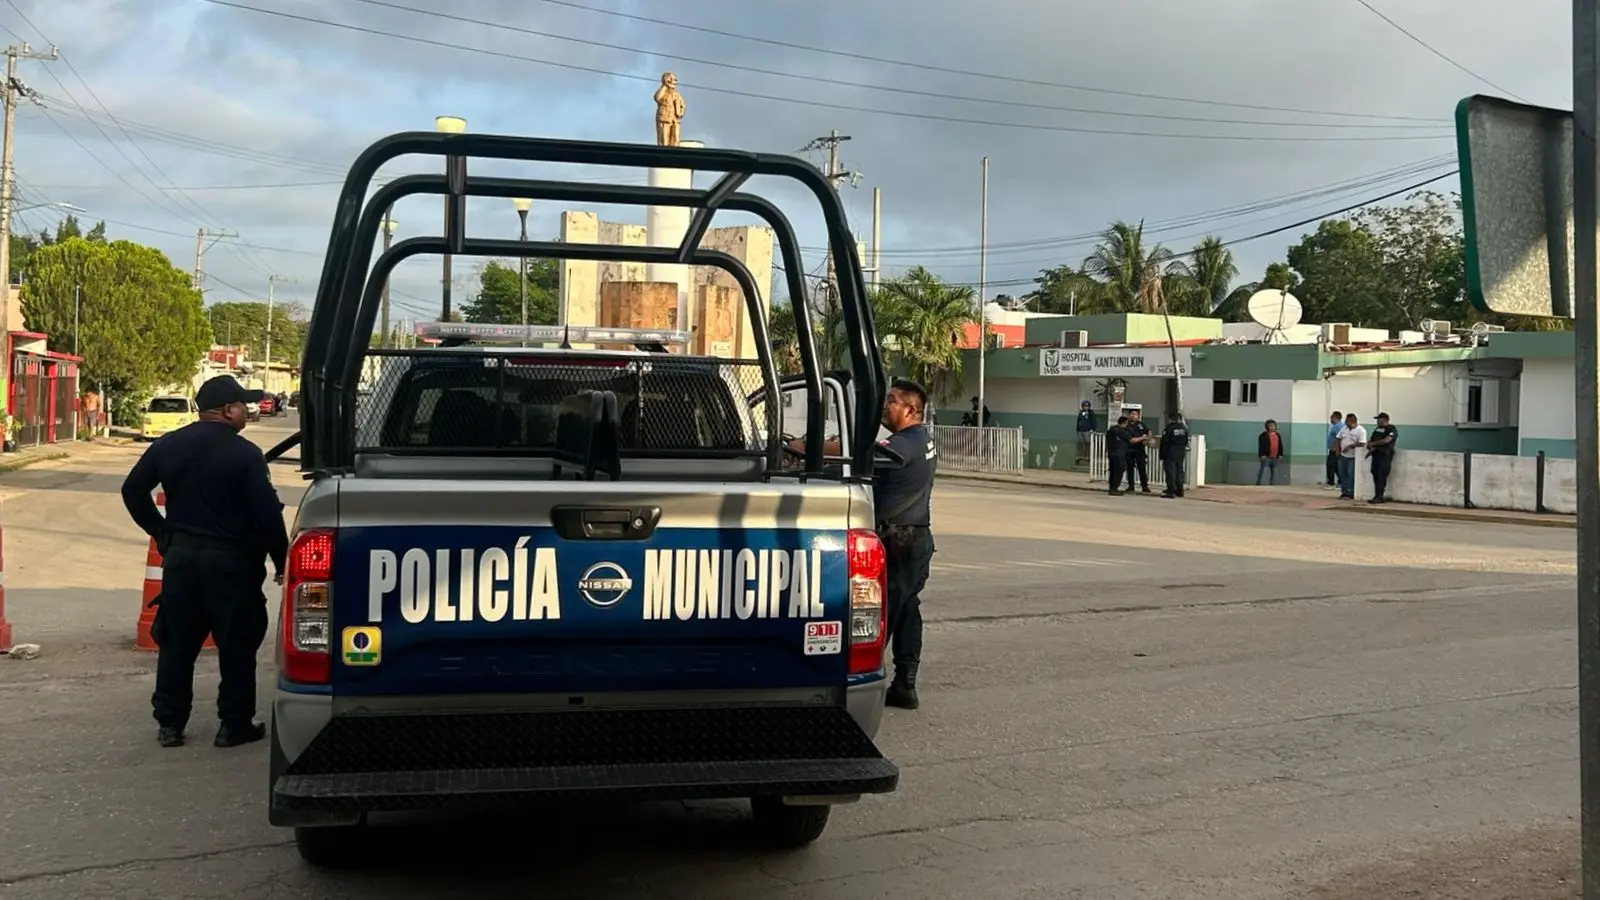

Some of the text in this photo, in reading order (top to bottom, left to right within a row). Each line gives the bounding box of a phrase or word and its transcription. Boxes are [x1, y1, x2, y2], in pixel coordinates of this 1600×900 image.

[1061, 353, 1144, 368] HOSPITAL KANTUNILKIN
[368, 537, 824, 622] POLICÍA MUNICIPAL
[578, 580, 631, 589] NISSAN
[809, 625, 836, 636] 911
